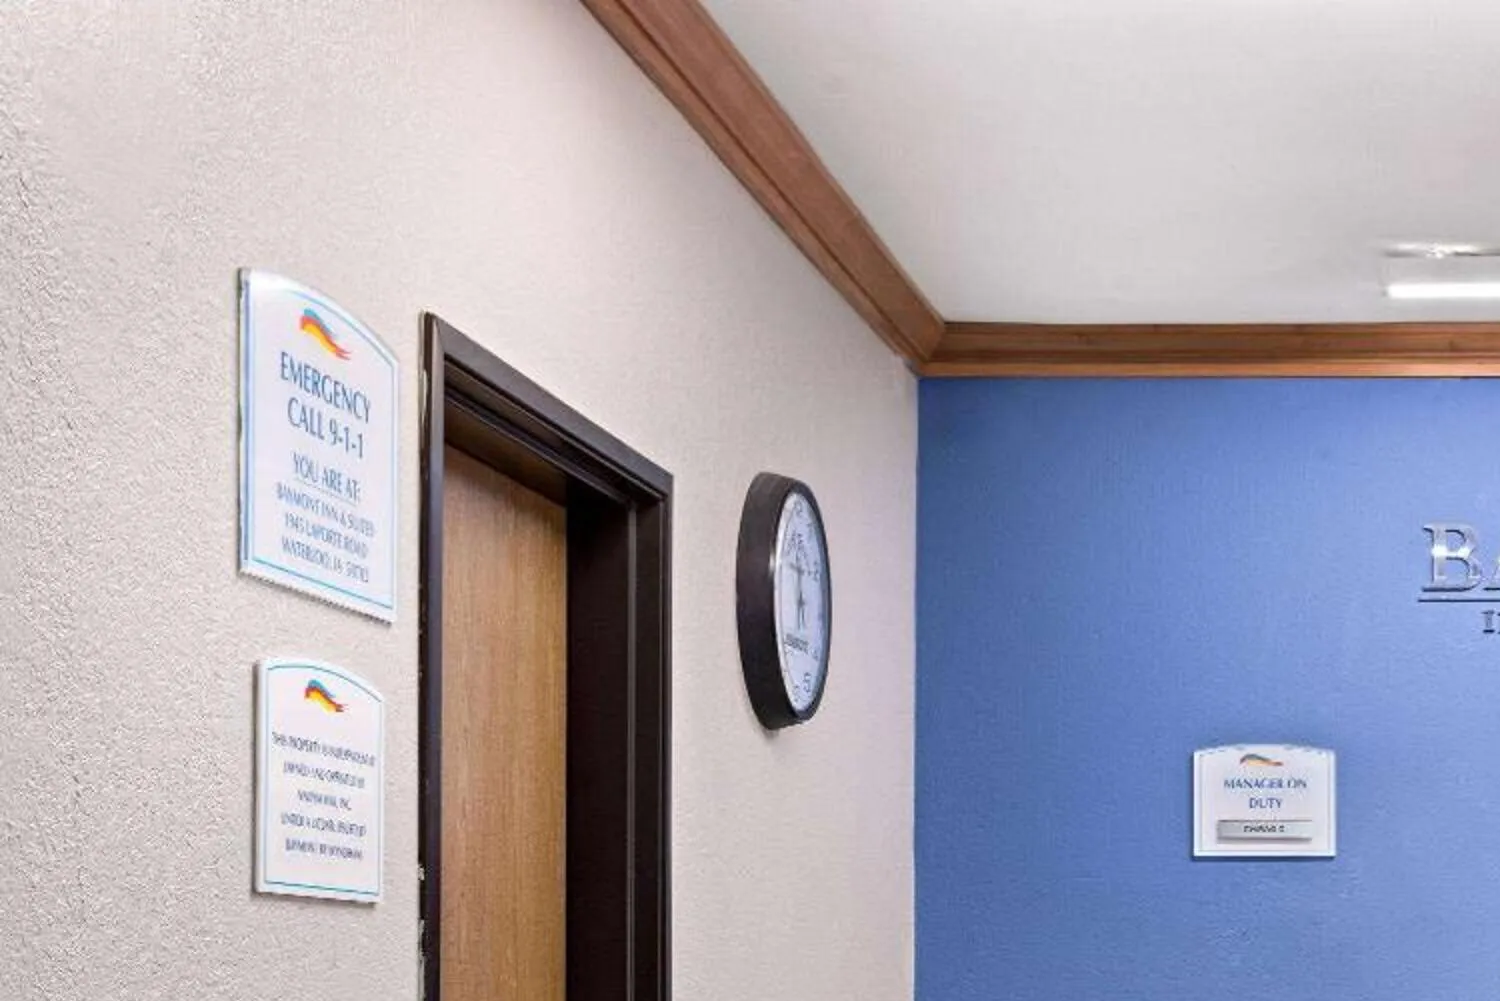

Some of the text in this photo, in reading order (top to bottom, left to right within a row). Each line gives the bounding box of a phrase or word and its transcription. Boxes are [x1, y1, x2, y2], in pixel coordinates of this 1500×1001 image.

[281, 351, 370, 423] EMERGENCY
[287, 397, 363, 459] CALL 9-1-1
[293, 452, 319, 483] YOU
[322, 468, 341, 494] ARE
[1224, 778, 1307, 789] MANAGER ON
[1249, 797, 1283, 809] DUTY
